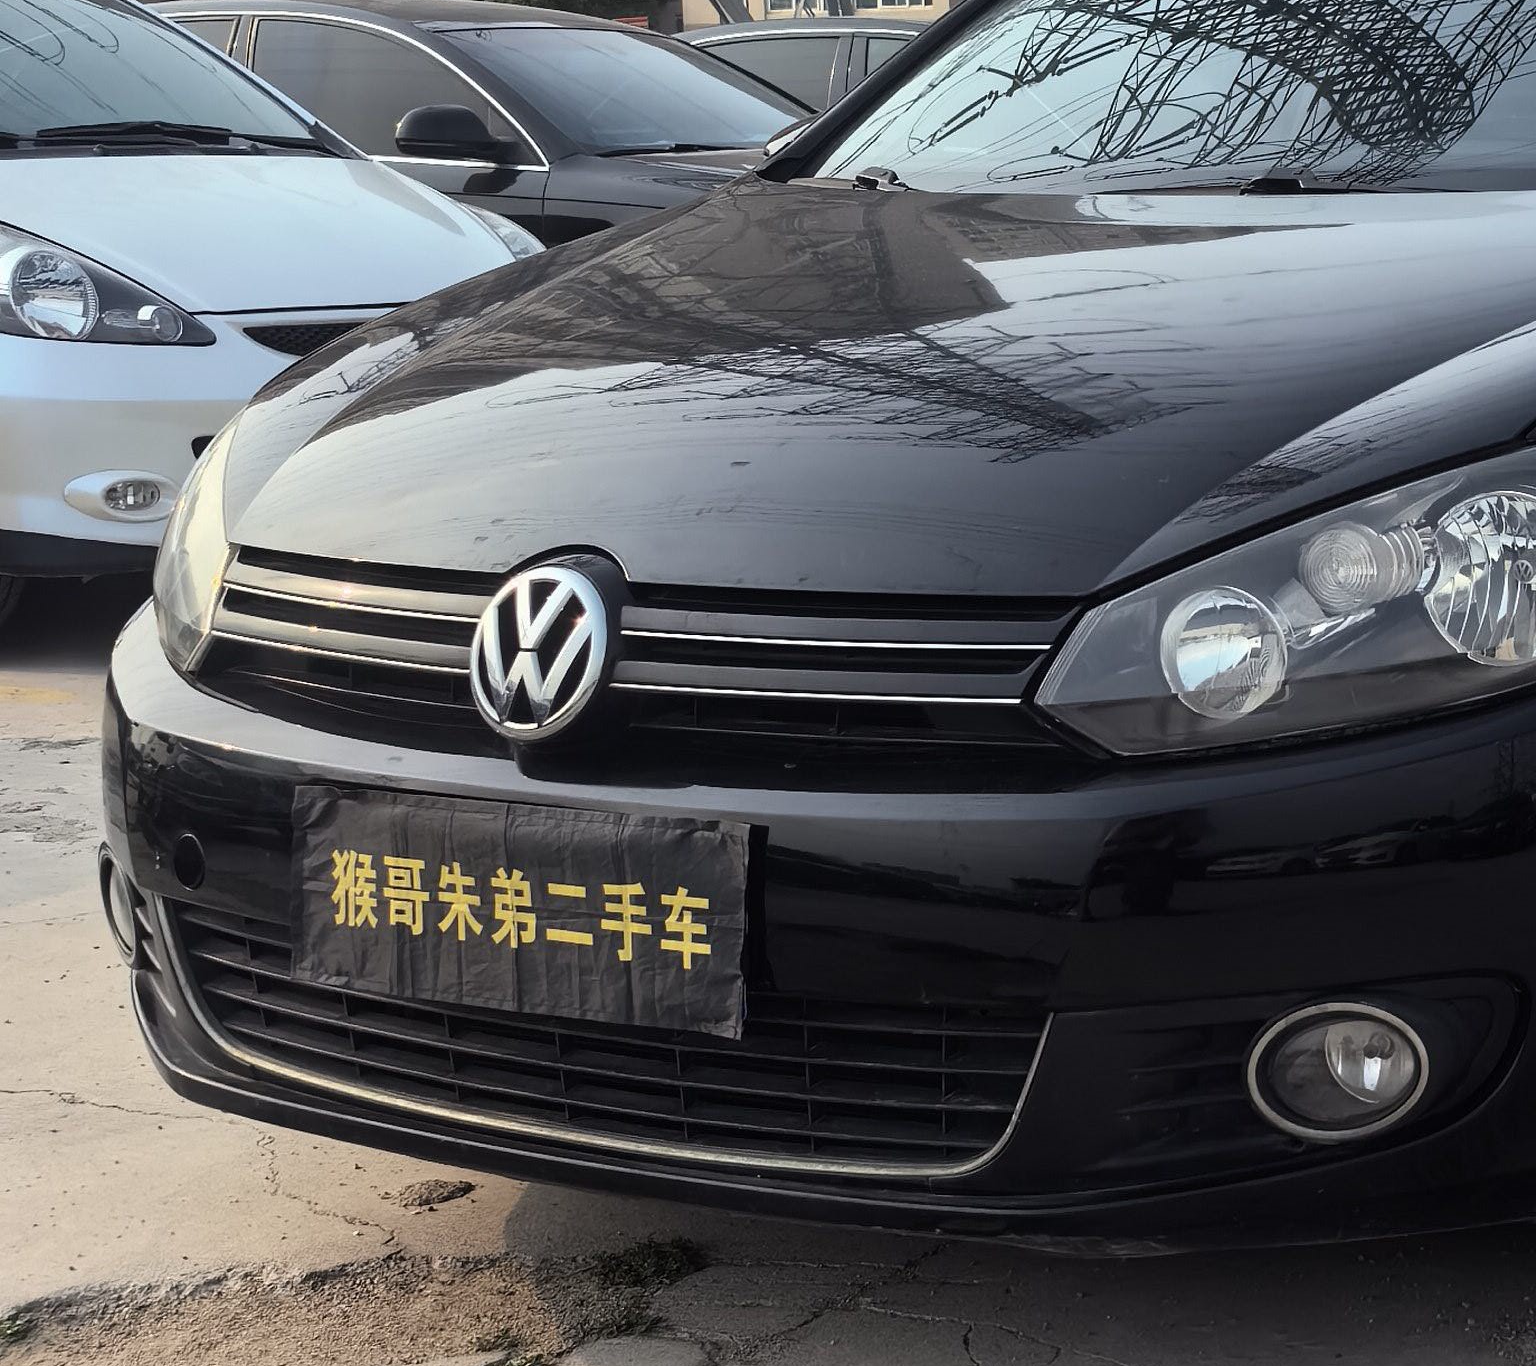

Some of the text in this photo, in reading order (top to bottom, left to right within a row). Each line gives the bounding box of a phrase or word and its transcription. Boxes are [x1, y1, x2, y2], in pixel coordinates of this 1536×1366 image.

[331, 847, 713, 971] 猴哥朱弟二手车
